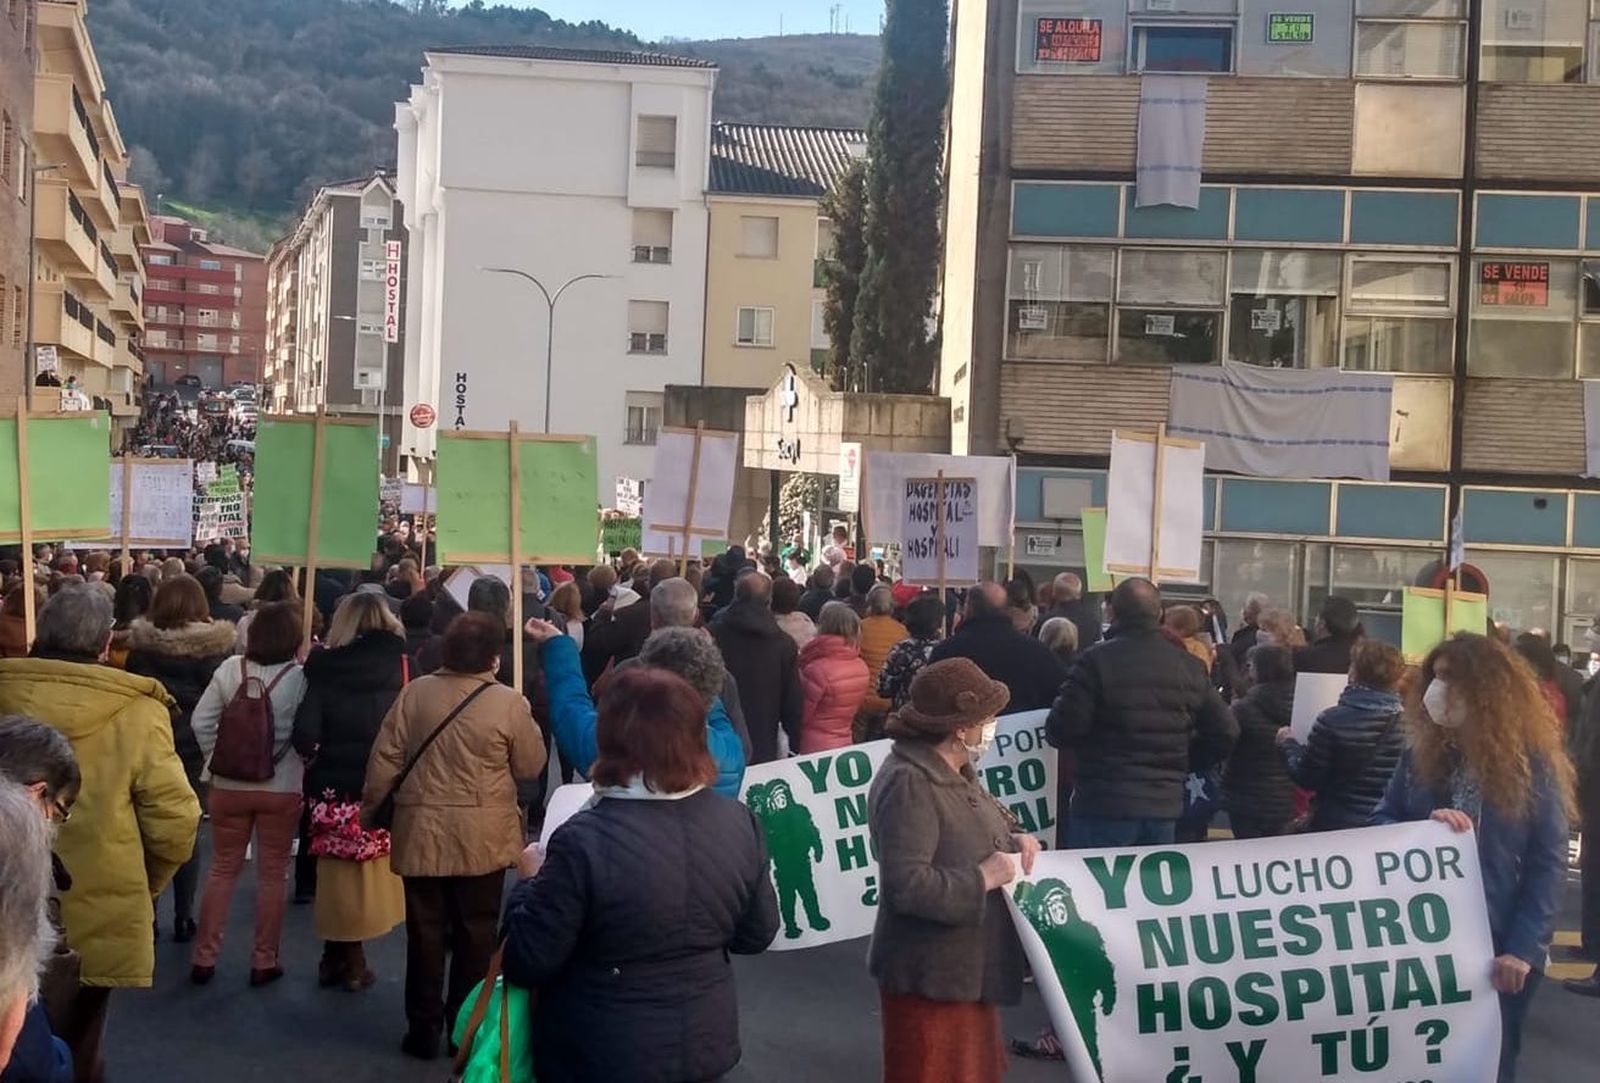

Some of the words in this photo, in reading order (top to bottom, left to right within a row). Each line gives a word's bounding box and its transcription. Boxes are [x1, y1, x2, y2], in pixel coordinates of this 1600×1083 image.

[1040, 20, 1053, 33] SE
[1055, 20, 1100, 33] ALQUILA
[1484, 264, 1500, 279] SE
[1504, 263, 1547, 280] VENDE
[386, 263, 398, 339] HOSTAL
[455, 373, 467, 430] HOSTA
[909, 501, 963, 521] HOSPIAL
[908, 537, 960, 558] HOSPIALI
[797, 750, 872, 794] YO
[1083, 851, 1193, 910] YO
[1213, 855, 1353, 900] LUCHO
[1375, 846, 1464, 885] POR
[1136, 893, 1452, 969] NUESTRO
[1136, 954, 1472, 1035] HOSPITAL
